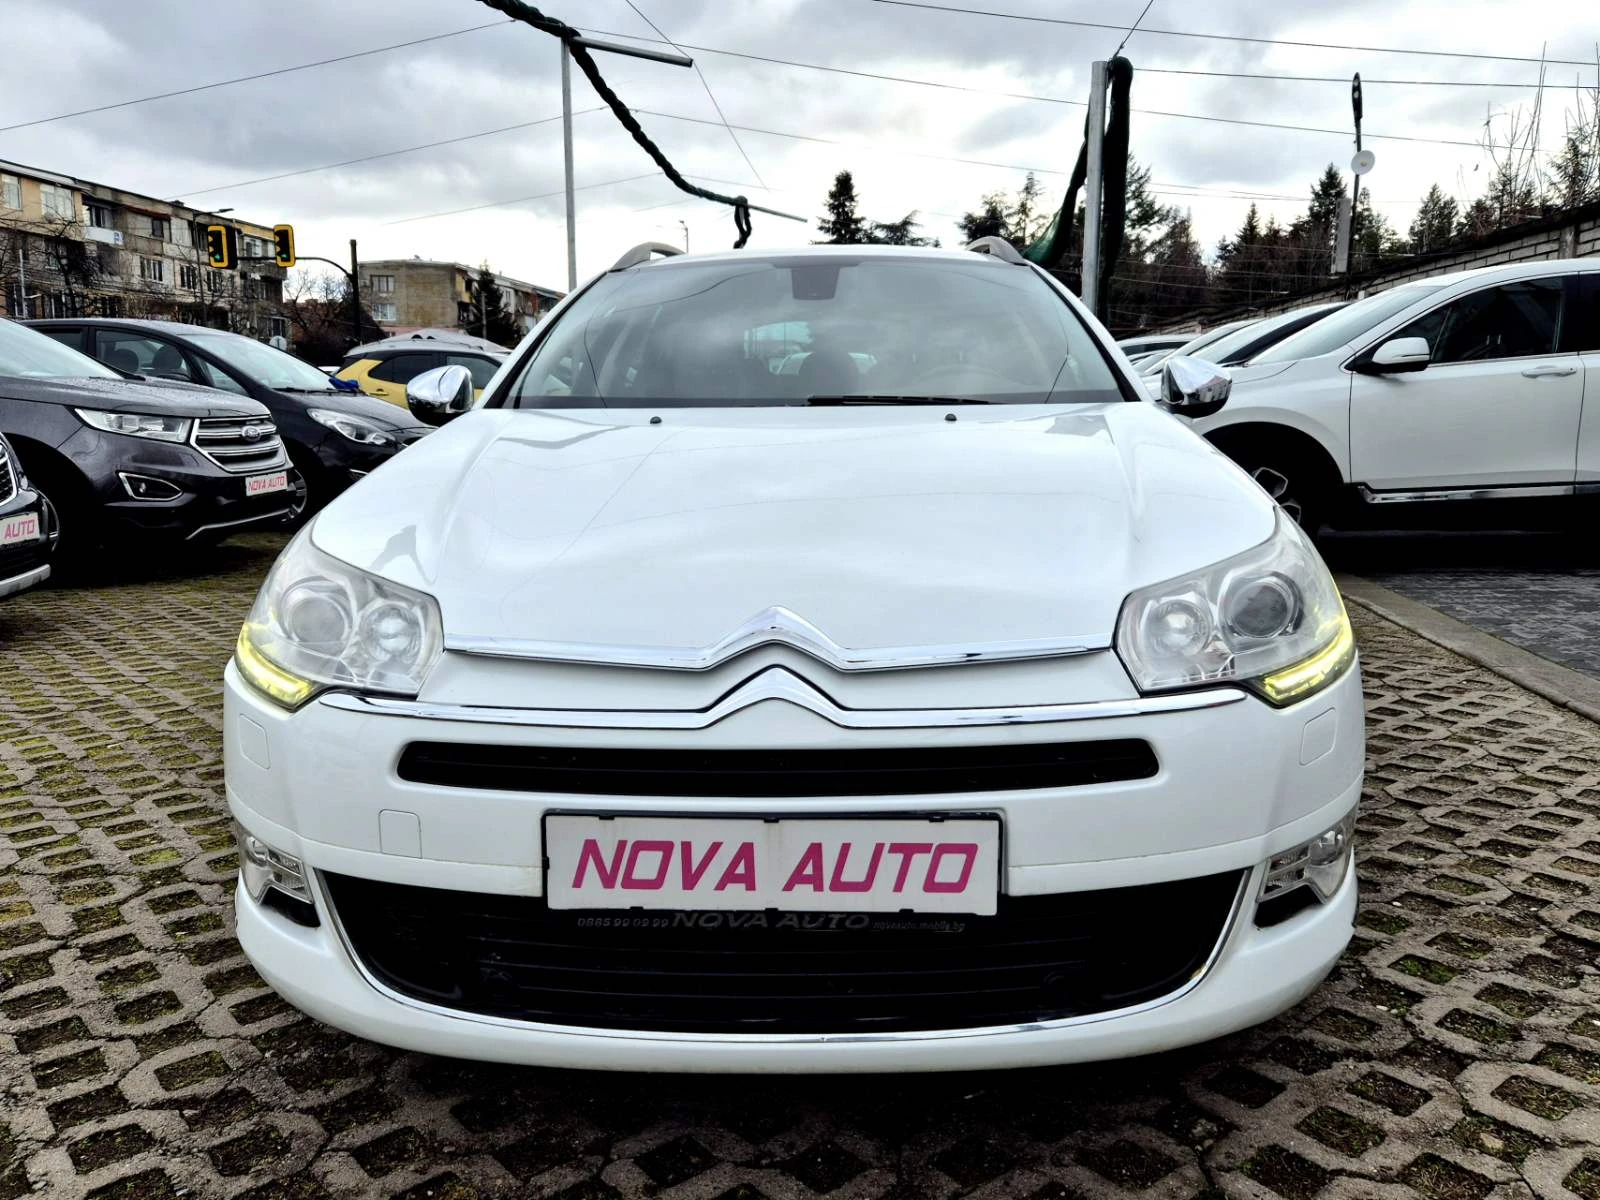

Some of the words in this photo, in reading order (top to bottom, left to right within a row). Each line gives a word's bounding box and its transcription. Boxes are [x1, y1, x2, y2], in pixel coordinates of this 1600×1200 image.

[268, 476, 284, 488] AUTO
[4, 519, 35, 539] AUTO
[572, 839, 756, 891] NOVA
[782, 842, 979, 893] AUTO
[672, 911, 768, 928] NOVA
[776, 913, 870, 929] AUTO
